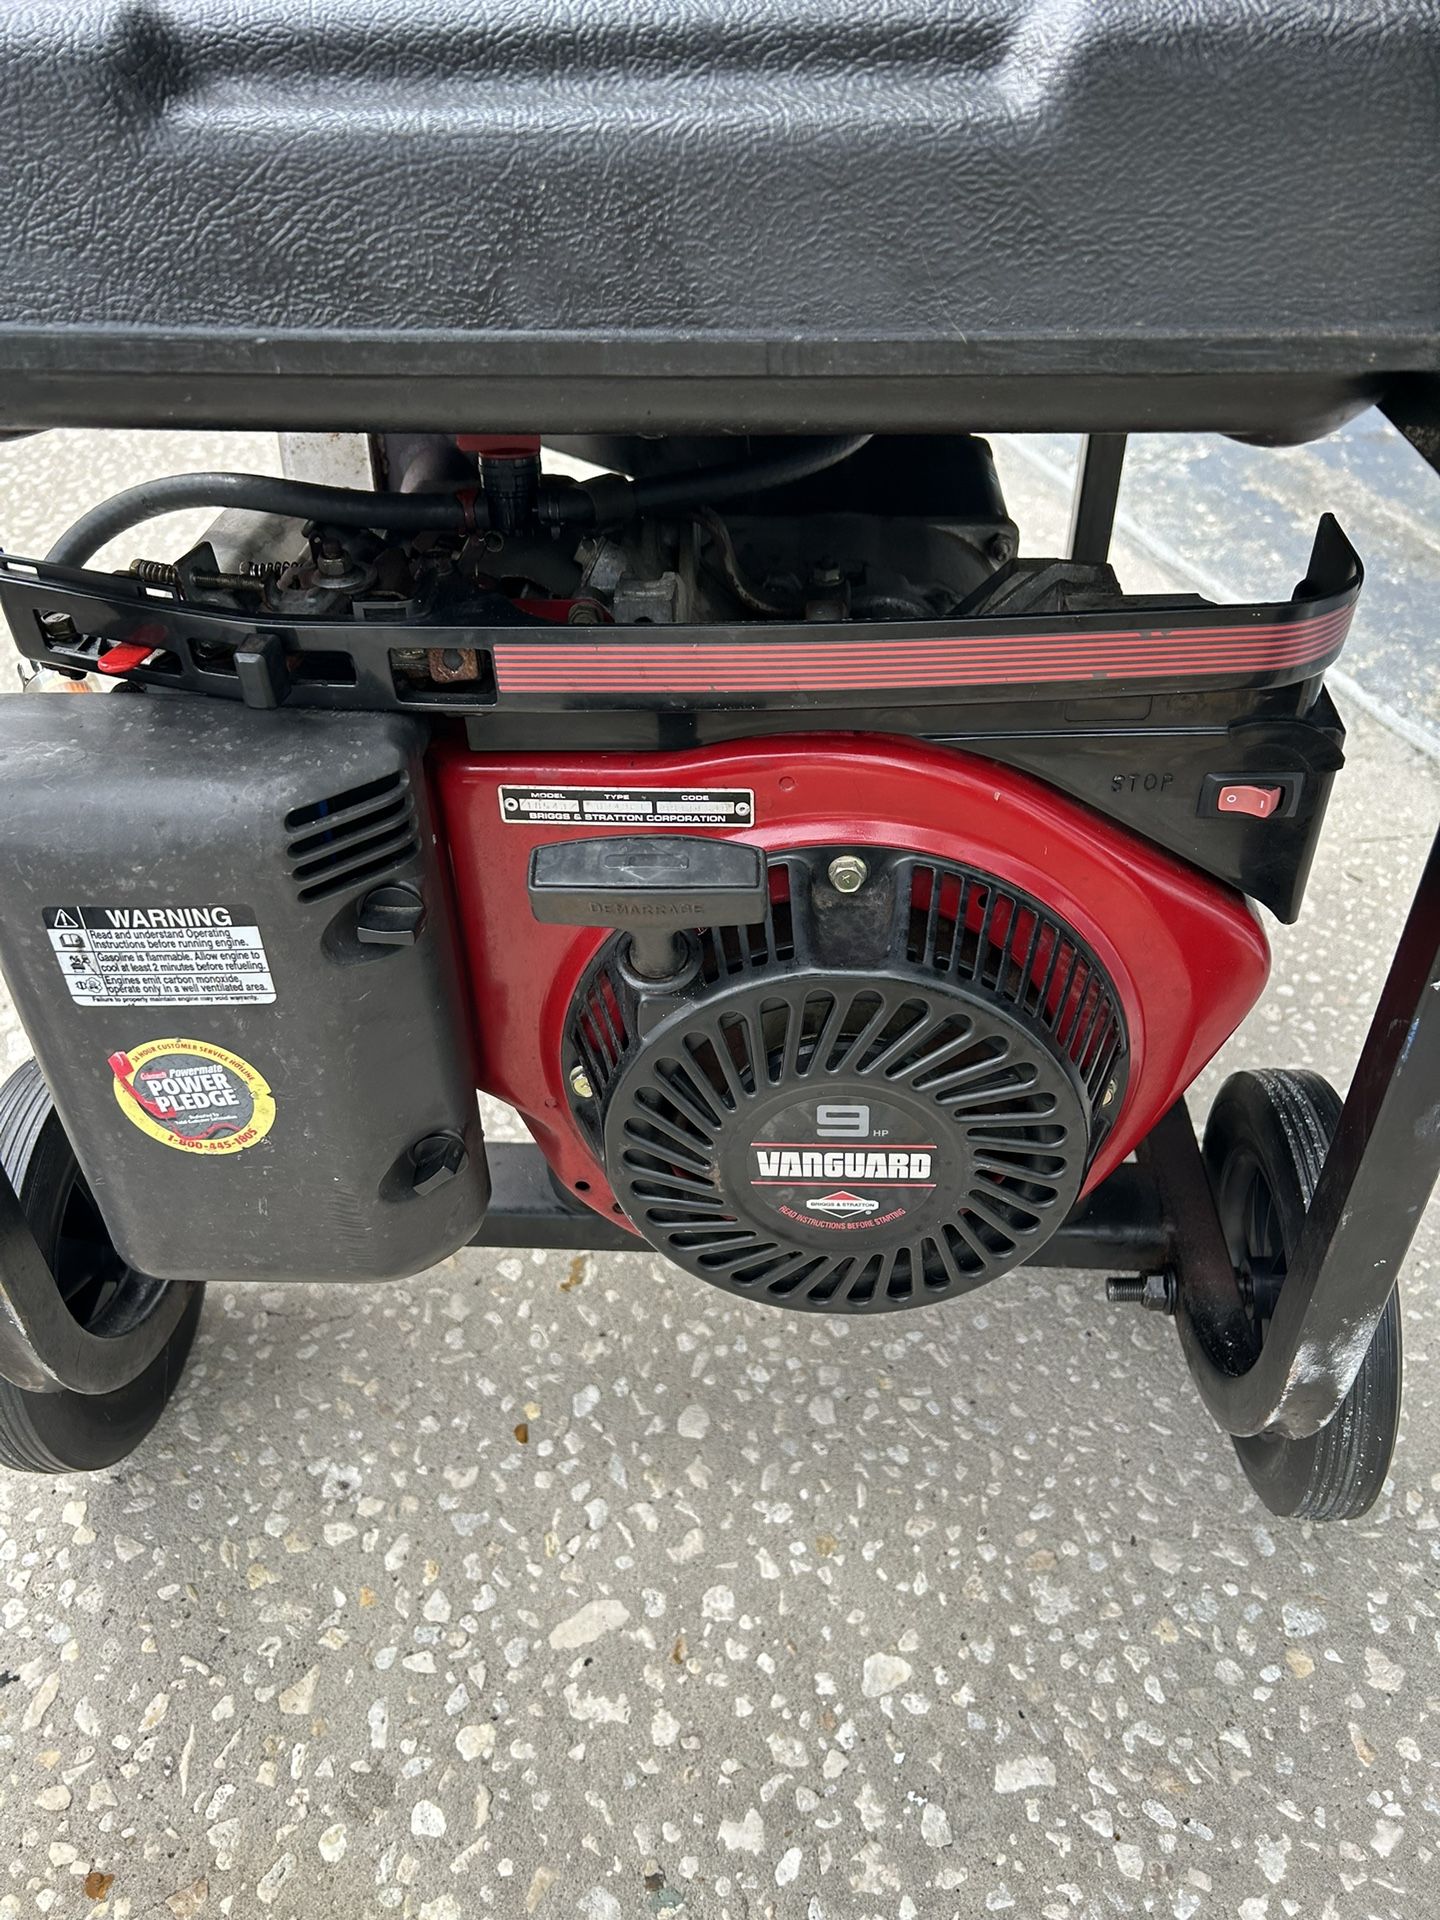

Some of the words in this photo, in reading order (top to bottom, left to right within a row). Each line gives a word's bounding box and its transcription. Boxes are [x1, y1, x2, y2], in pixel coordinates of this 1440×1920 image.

[1111, 772, 1174, 793] STOP
[646, 814, 726, 822] CORPORATION
[105, 907, 233, 928] WARNING
[90, 930, 113, 939] Read
[114, 930, 131, 939] and
[133, 929, 184, 939] understand
[185, 929, 232, 940] Operating
[94, 940, 145, 949] Instructions
[147, 940, 177, 949] before
[178, 940, 214, 950] running
[215, 939, 249, 949] engine.
[98, 952, 135, 962] Gasoline
[136, 953, 145, 961] is
[145, 951, 193, 961] flammable.
[194, 951, 218, 960] Allow
[219, 951, 250, 963] engine
[250, 951, 261, 959] to
[101, 963, 120, 972] cool
[121, 963, 130, 971] at
[131, 962, 152, 971] least
[152, 962, 159, 970] 2
[160, 962, 195, 972] minutes
[196, 962, 225, 971] before
[105, 975, 141, 985] Engines
[142, 975, 162, 984] emit
[163, 974, 194, 984] carbon
[108, 986, 141, 996] operate
[142, 985, 162, 995] only
[163, 984, 174, 993] in
[182, 984, 199, 993] well
[200, 983, 244, 993] ventilated
[245, 983, 268, 991] area.
[138, 1046, 156, 1058] HOUR
[157, 1043, 198, 1051] CUSTOMER
[199, 1046, 229, 1062] SERVICE
[229, 1059, 255, 1081] HOTLINE
[169, 1064, 222, 1078] Powermate
[146, 1075, 232, 1097] POWER
[154, 1090, 240, 1113] PLEDGE
[816, 1104, 870, 1137] 9
[167, 1128, 258, 1150] 1-800-445-1805
[756, 1151, 932, 1179] VANGUARD
[779, 1204, 798, 1219] READ
[795, 1214, 846, 1230] INSTRUCTIONS
[847, 1219, 875, 1229] BEFORE
[873, 1207, 906, 1226] STARTING
